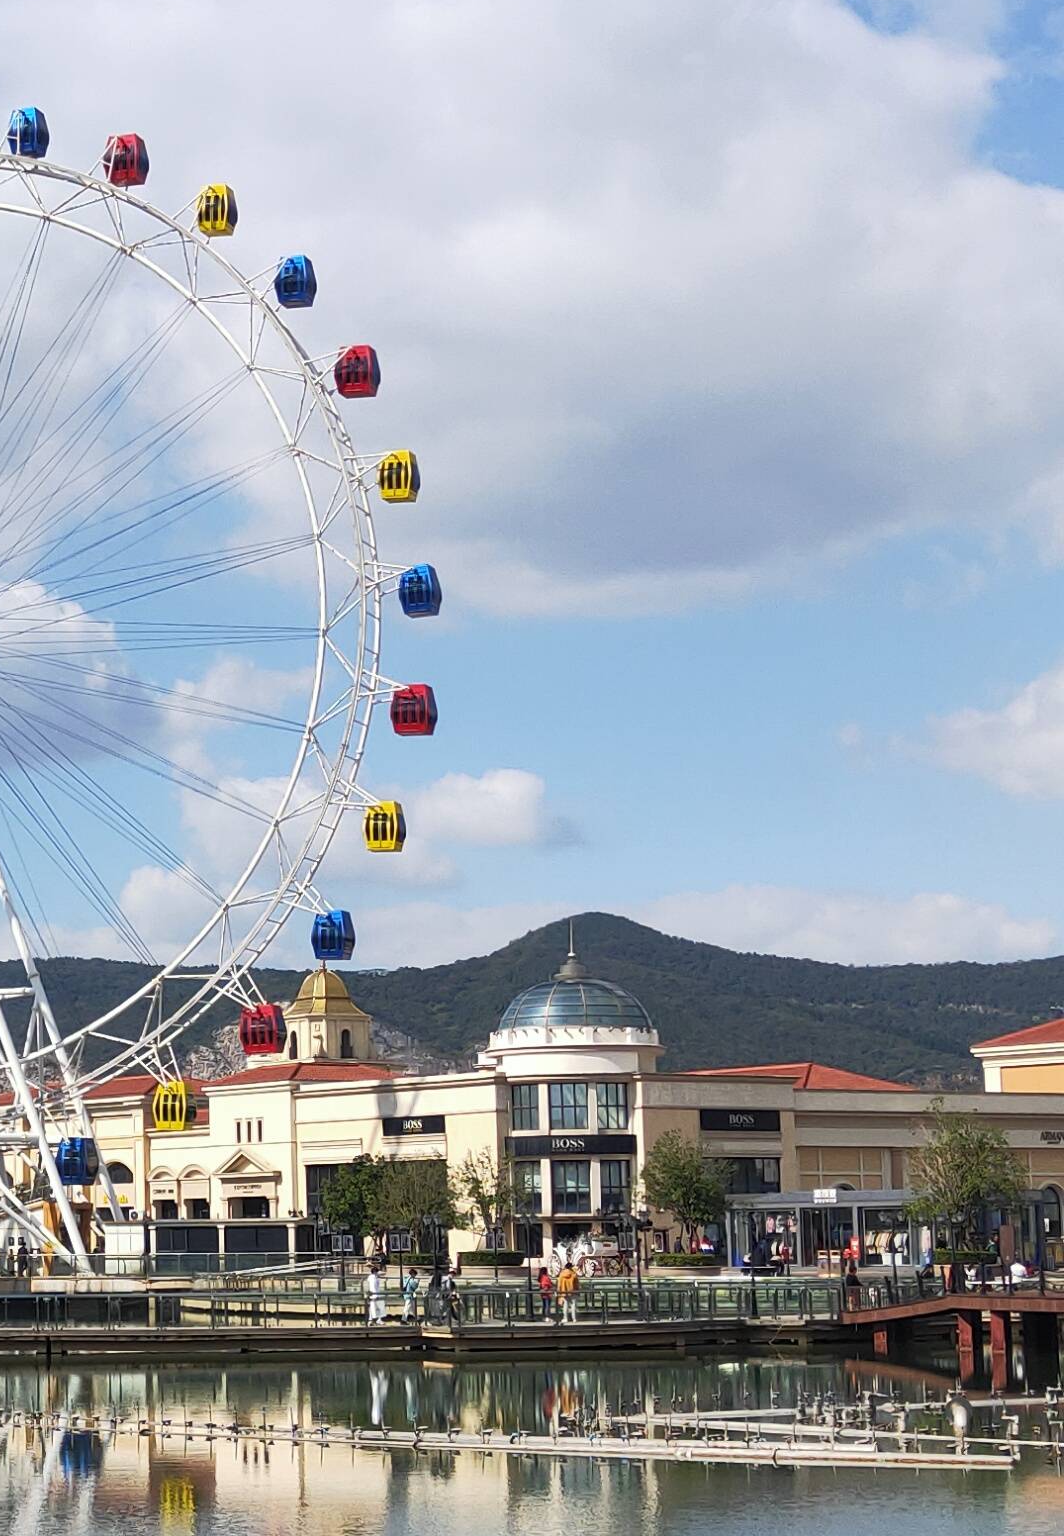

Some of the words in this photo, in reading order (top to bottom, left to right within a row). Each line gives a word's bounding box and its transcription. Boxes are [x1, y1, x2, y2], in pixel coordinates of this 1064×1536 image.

[402, 1117, 423, 1129] BOSS
[729, 1114, 754, 1124] BOSS
[551, 1138, 584, 1148] BOSS
